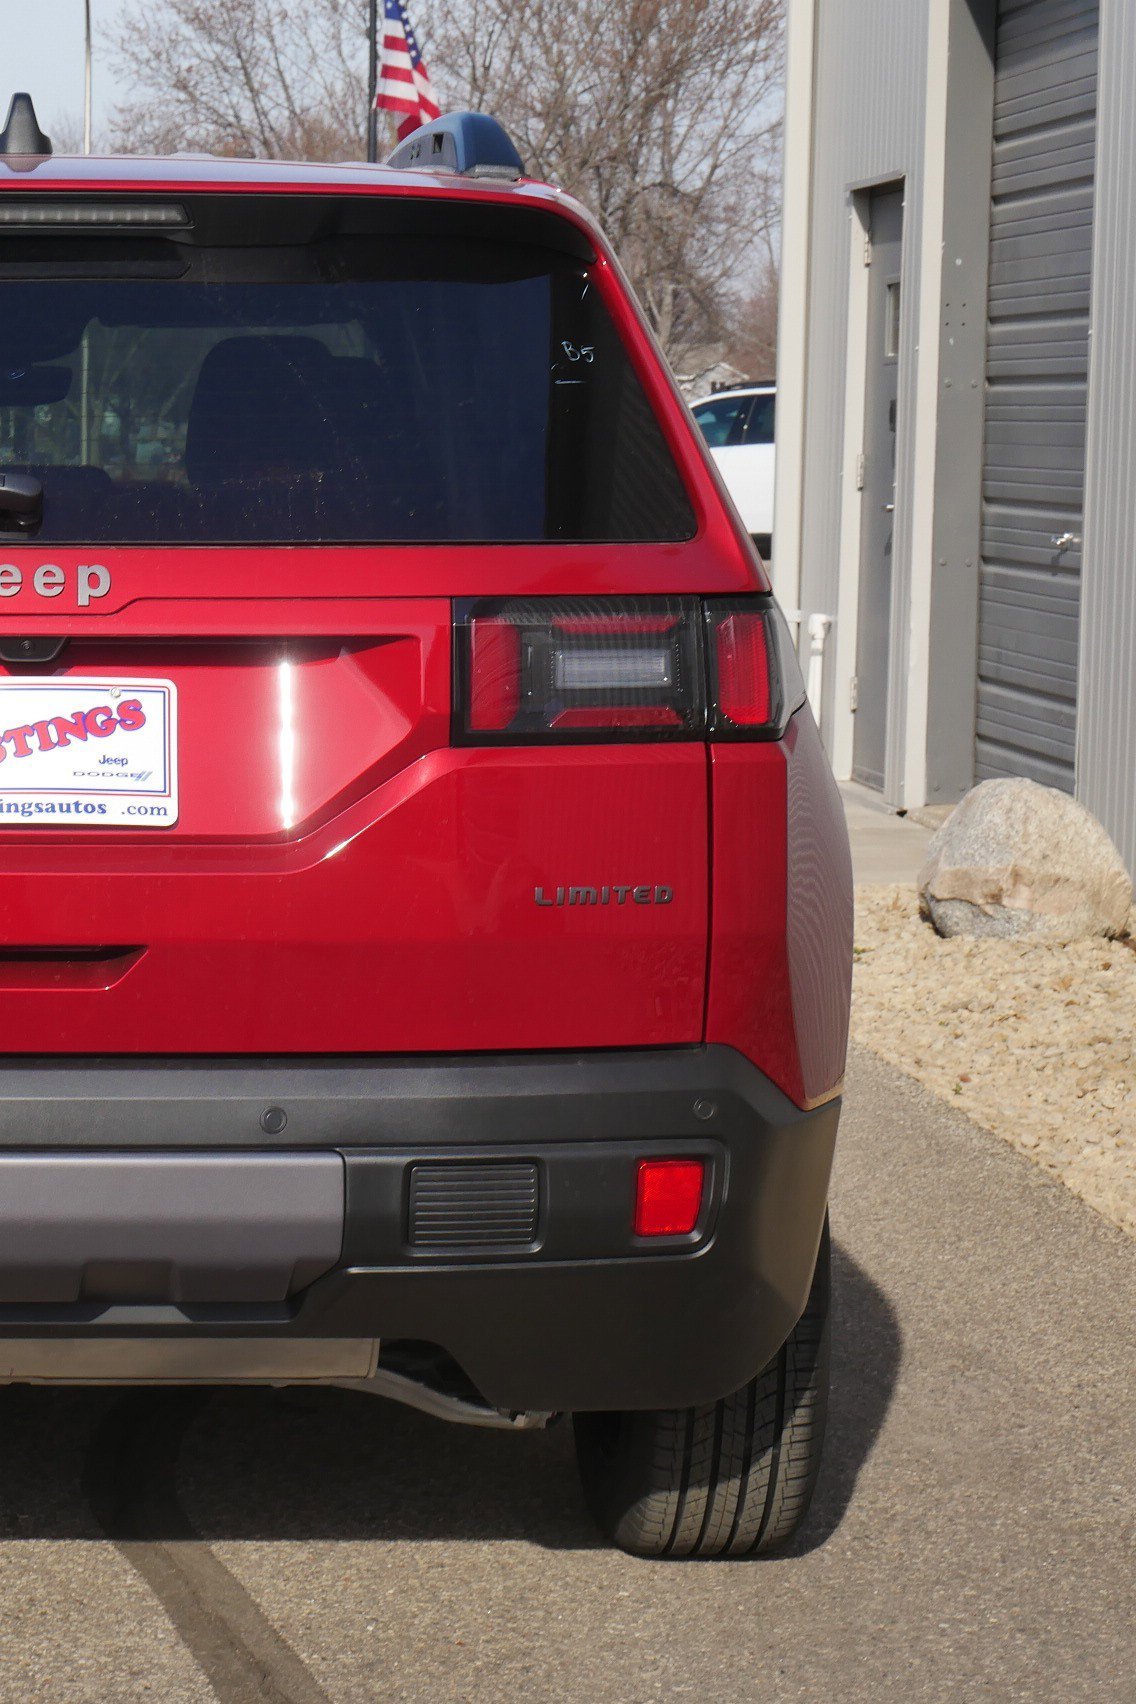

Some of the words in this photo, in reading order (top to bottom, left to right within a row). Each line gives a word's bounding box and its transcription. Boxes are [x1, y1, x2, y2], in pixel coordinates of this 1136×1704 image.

[561, 340, 595, 363] B5
[98, 754, 128, 767] Jeep
[121, 805, 168, 816] .com
[534, 885, 673, 906] LIMITED
